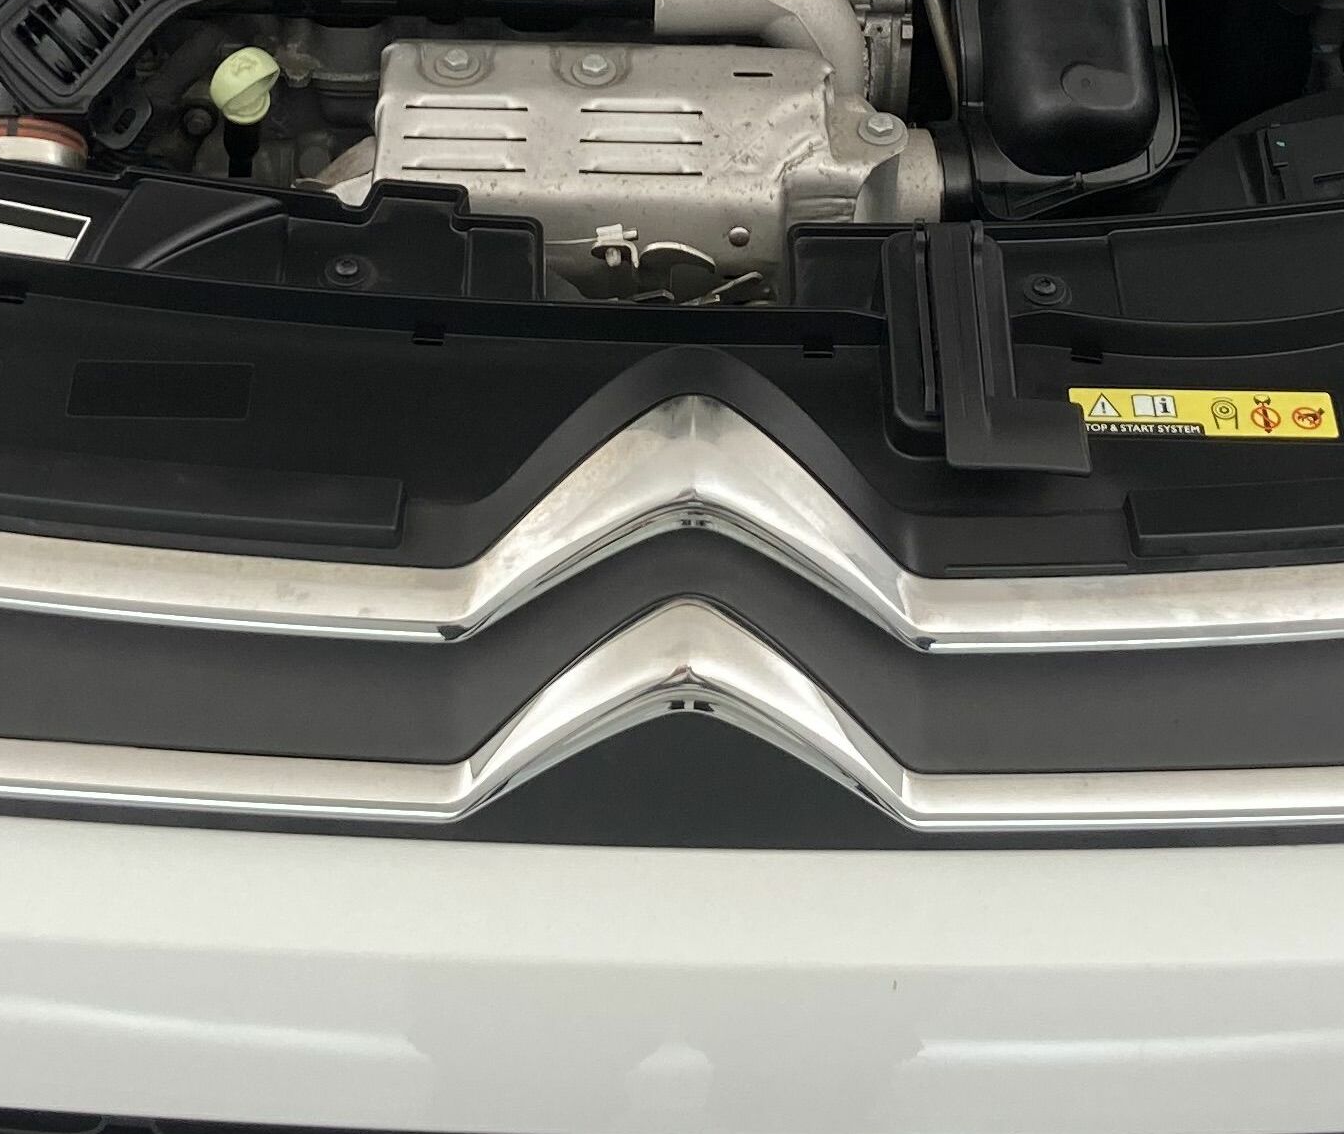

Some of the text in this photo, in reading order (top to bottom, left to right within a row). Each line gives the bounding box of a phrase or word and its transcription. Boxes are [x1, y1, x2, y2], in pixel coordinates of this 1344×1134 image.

[1086, 423, 1201, 434] TOP & START SYSTEM
